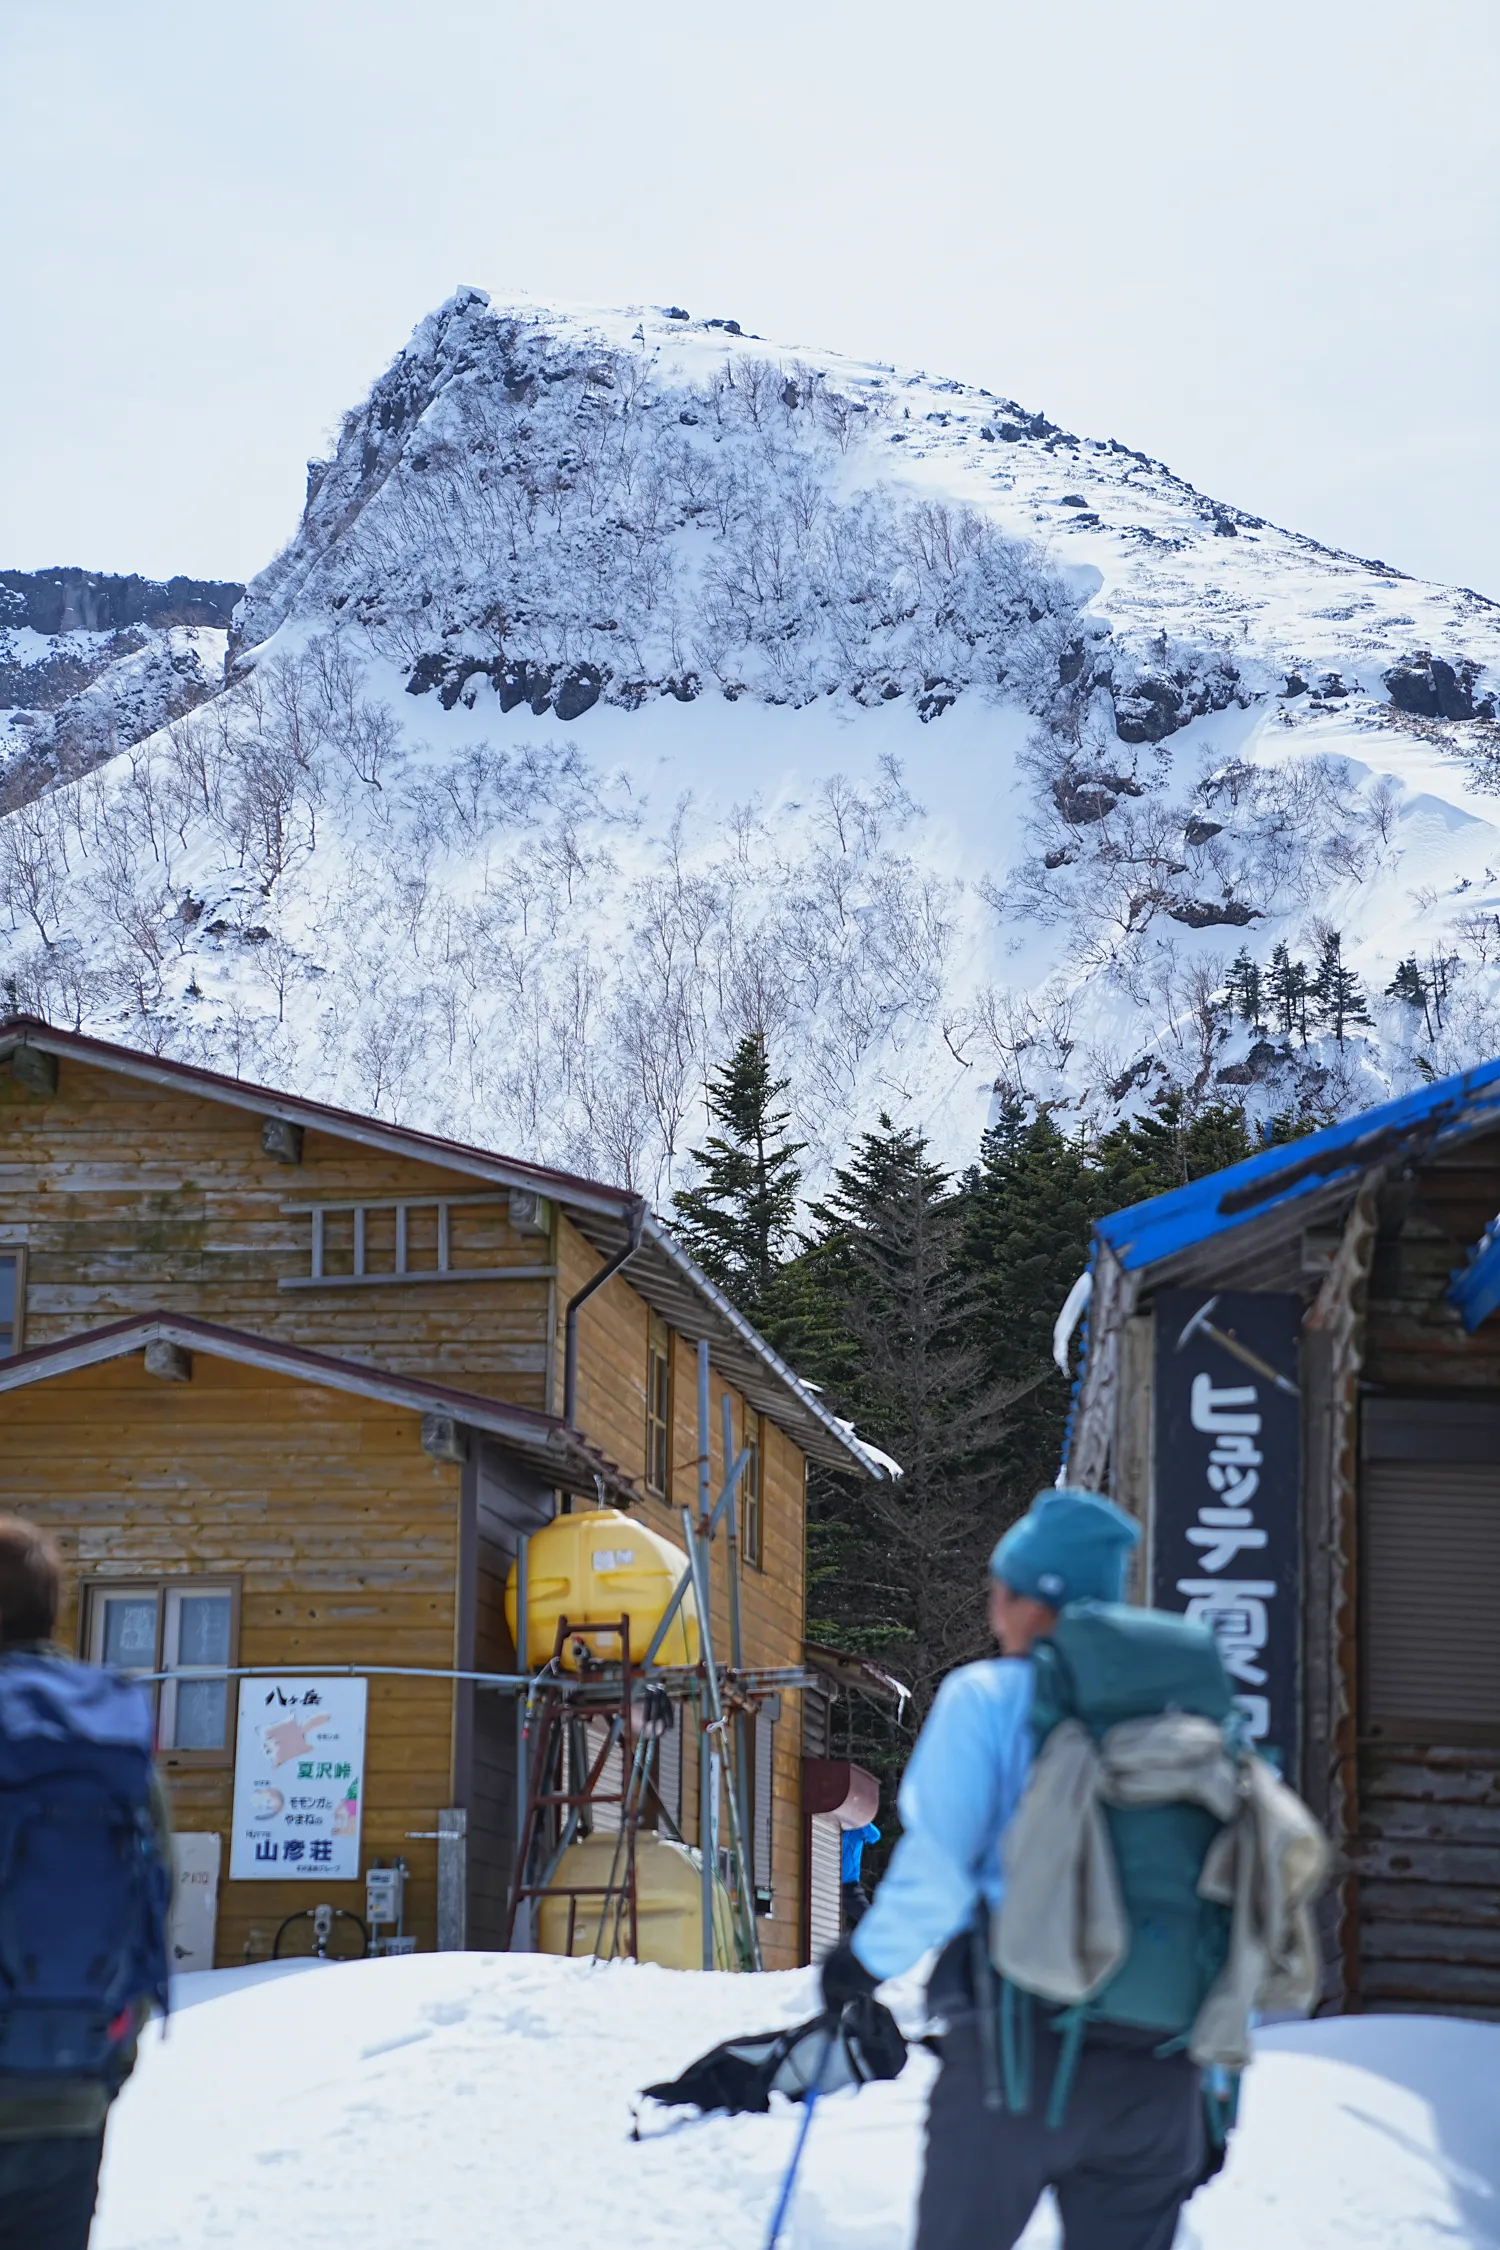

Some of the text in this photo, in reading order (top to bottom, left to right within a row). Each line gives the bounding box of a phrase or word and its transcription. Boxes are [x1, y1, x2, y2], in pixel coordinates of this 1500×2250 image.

[1176, 1372, 1281, 1775] ヒュッテ夏
[297, 1761, 351, 1779] 夏沢峠
[289, 1796, 332, 1809] モモンガと
[285, 1813, 323, 1826] やまねの
[255, 1839, 332, 1861] 山彦荘
